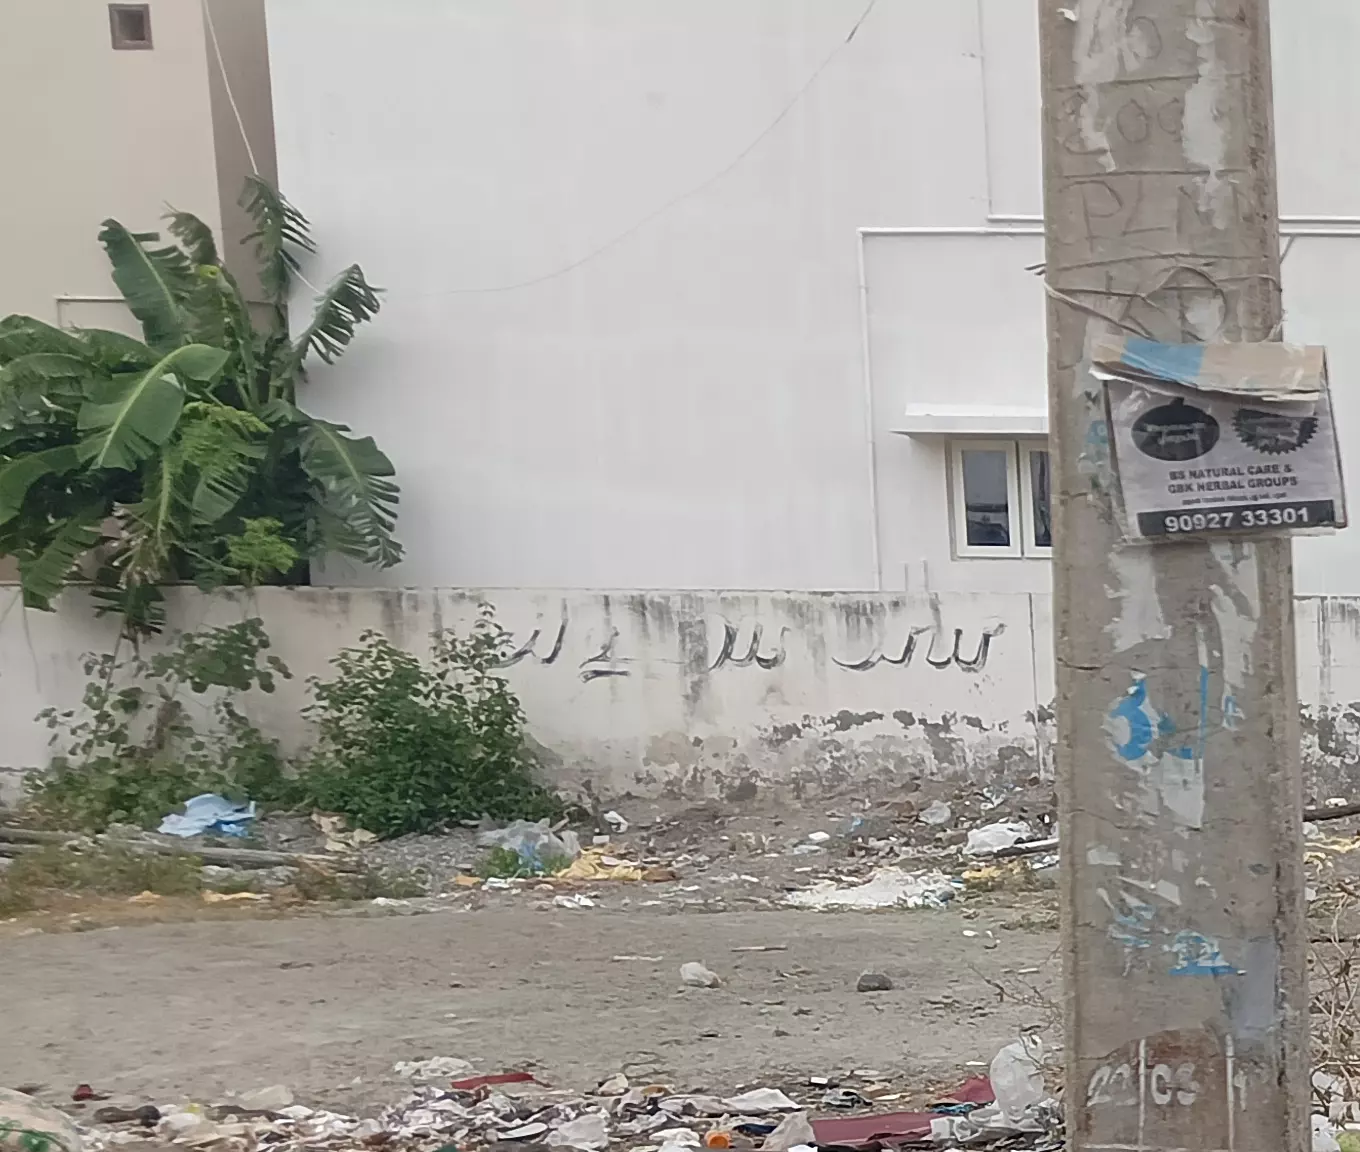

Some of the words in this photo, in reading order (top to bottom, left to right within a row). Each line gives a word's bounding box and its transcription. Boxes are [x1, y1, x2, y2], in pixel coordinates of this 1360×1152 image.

[1188, 466, 1245, 480] NATURAL
[1247, 464, 1281, 476] CARE
[1283, 463, 1294, 473] &
[1196, 479, 1245, 492] HERBAL
[1247, 476, 1299, 489] GROUPS
[1164, 511, 1234, 533] 90927
[1240, 506, 1310, 527] 33301
